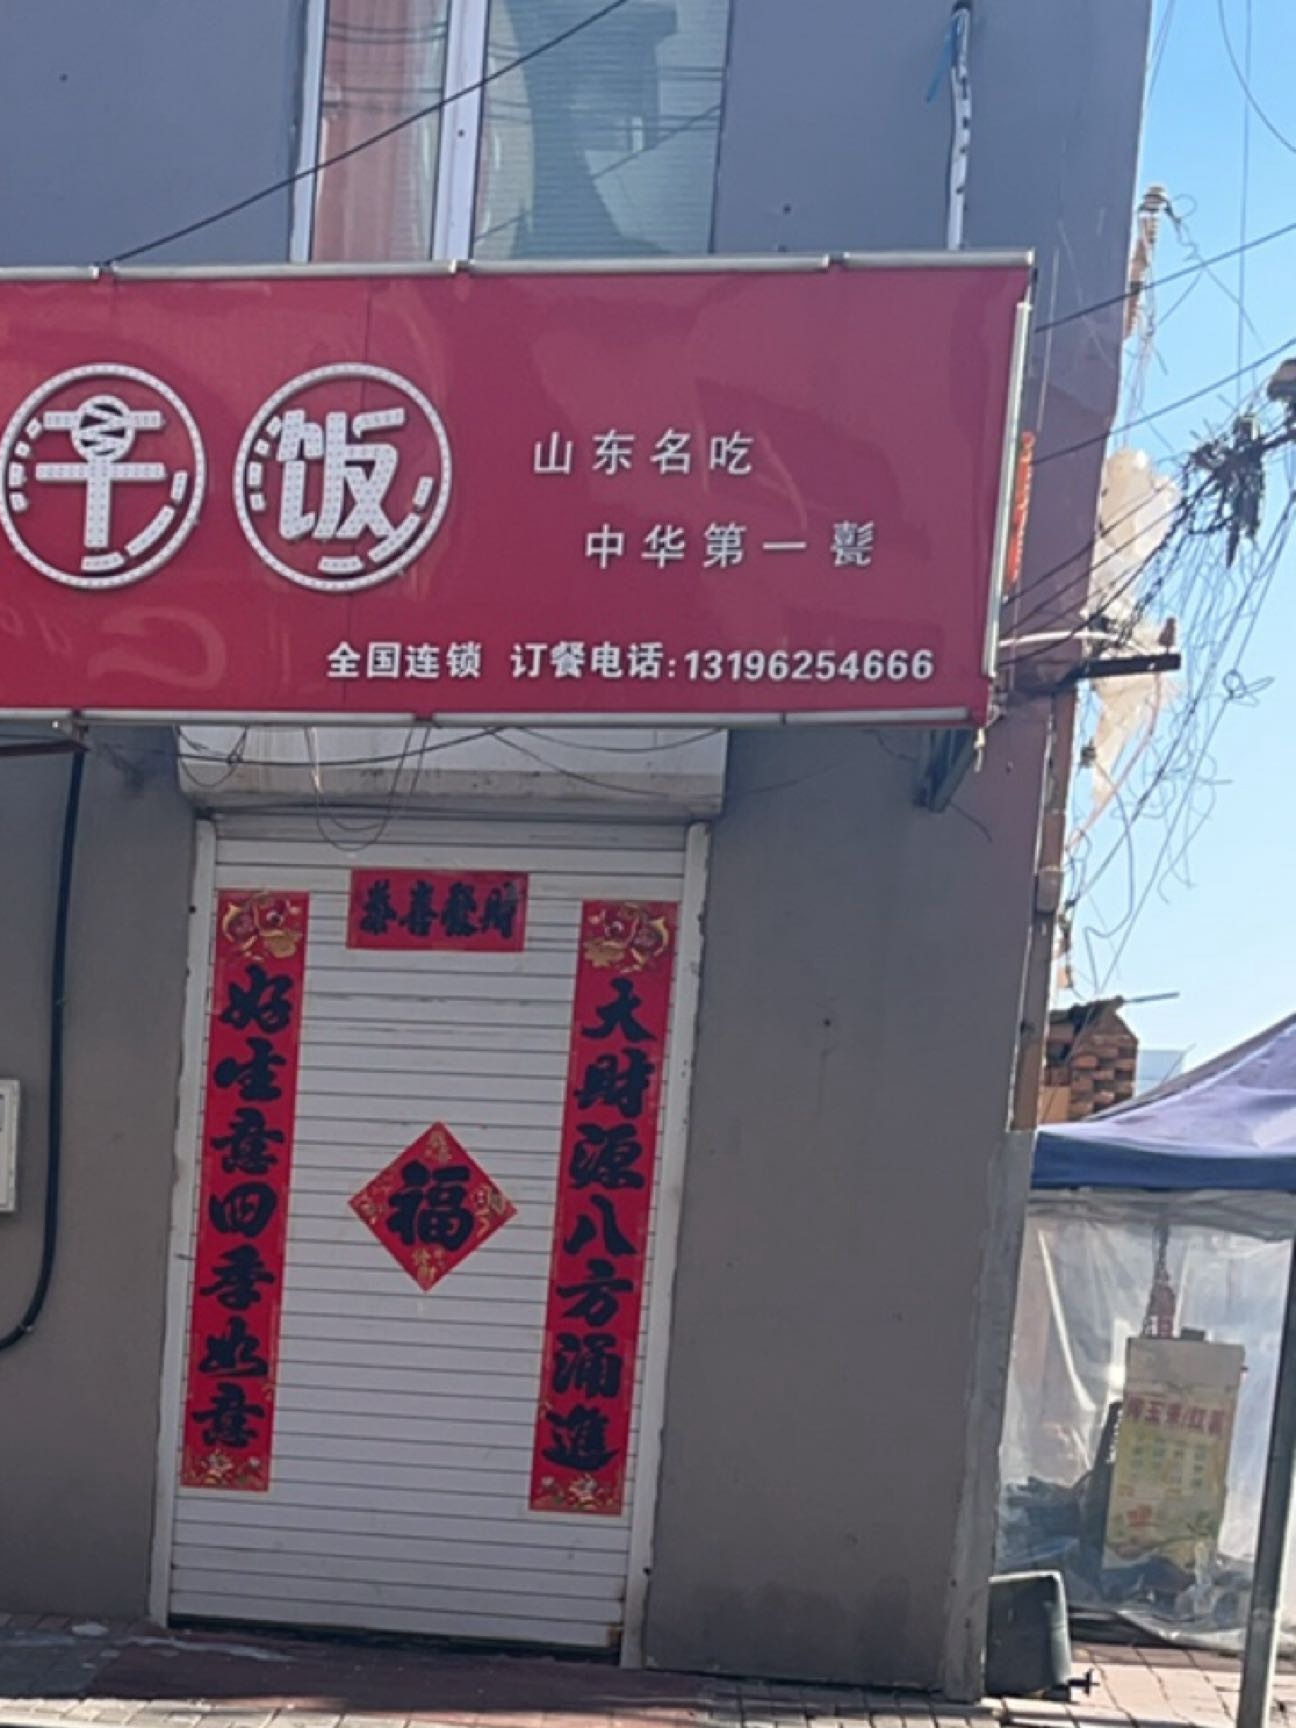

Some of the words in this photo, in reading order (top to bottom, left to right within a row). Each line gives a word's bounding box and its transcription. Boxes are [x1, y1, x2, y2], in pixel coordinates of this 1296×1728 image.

[533, 429, 754, 475] 山东名吃
[326, 640, 482, 679] 全国连锁
[386, 1158, 476, 1253] 福
